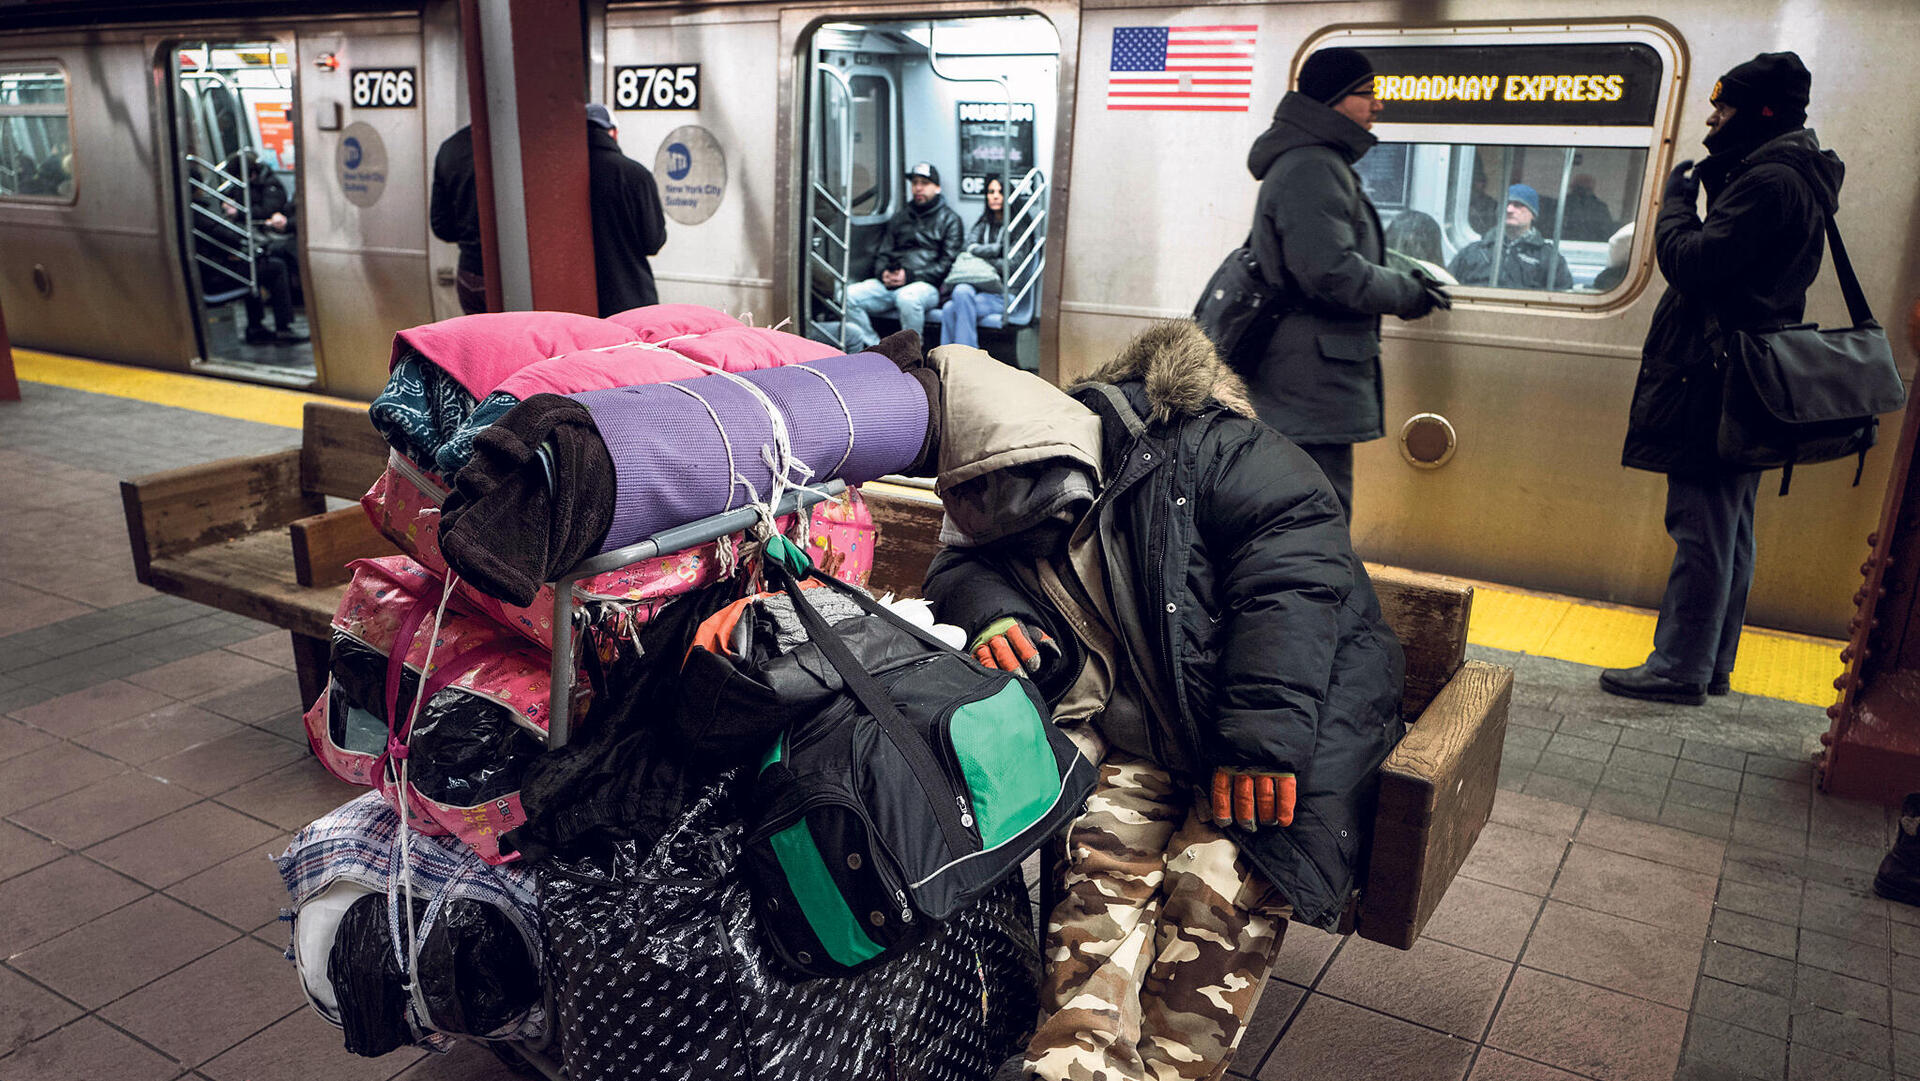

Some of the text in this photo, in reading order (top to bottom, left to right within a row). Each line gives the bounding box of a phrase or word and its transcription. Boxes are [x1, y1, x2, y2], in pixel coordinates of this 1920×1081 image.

[353, 71, 414, 106] 8766
[616, 66, 697, 108] 8765
[1374, 74, 1624, 101] BROADWAY EXPRESS
[704, 183, 722, 198] City
[962, 177, 985, 194] OF
